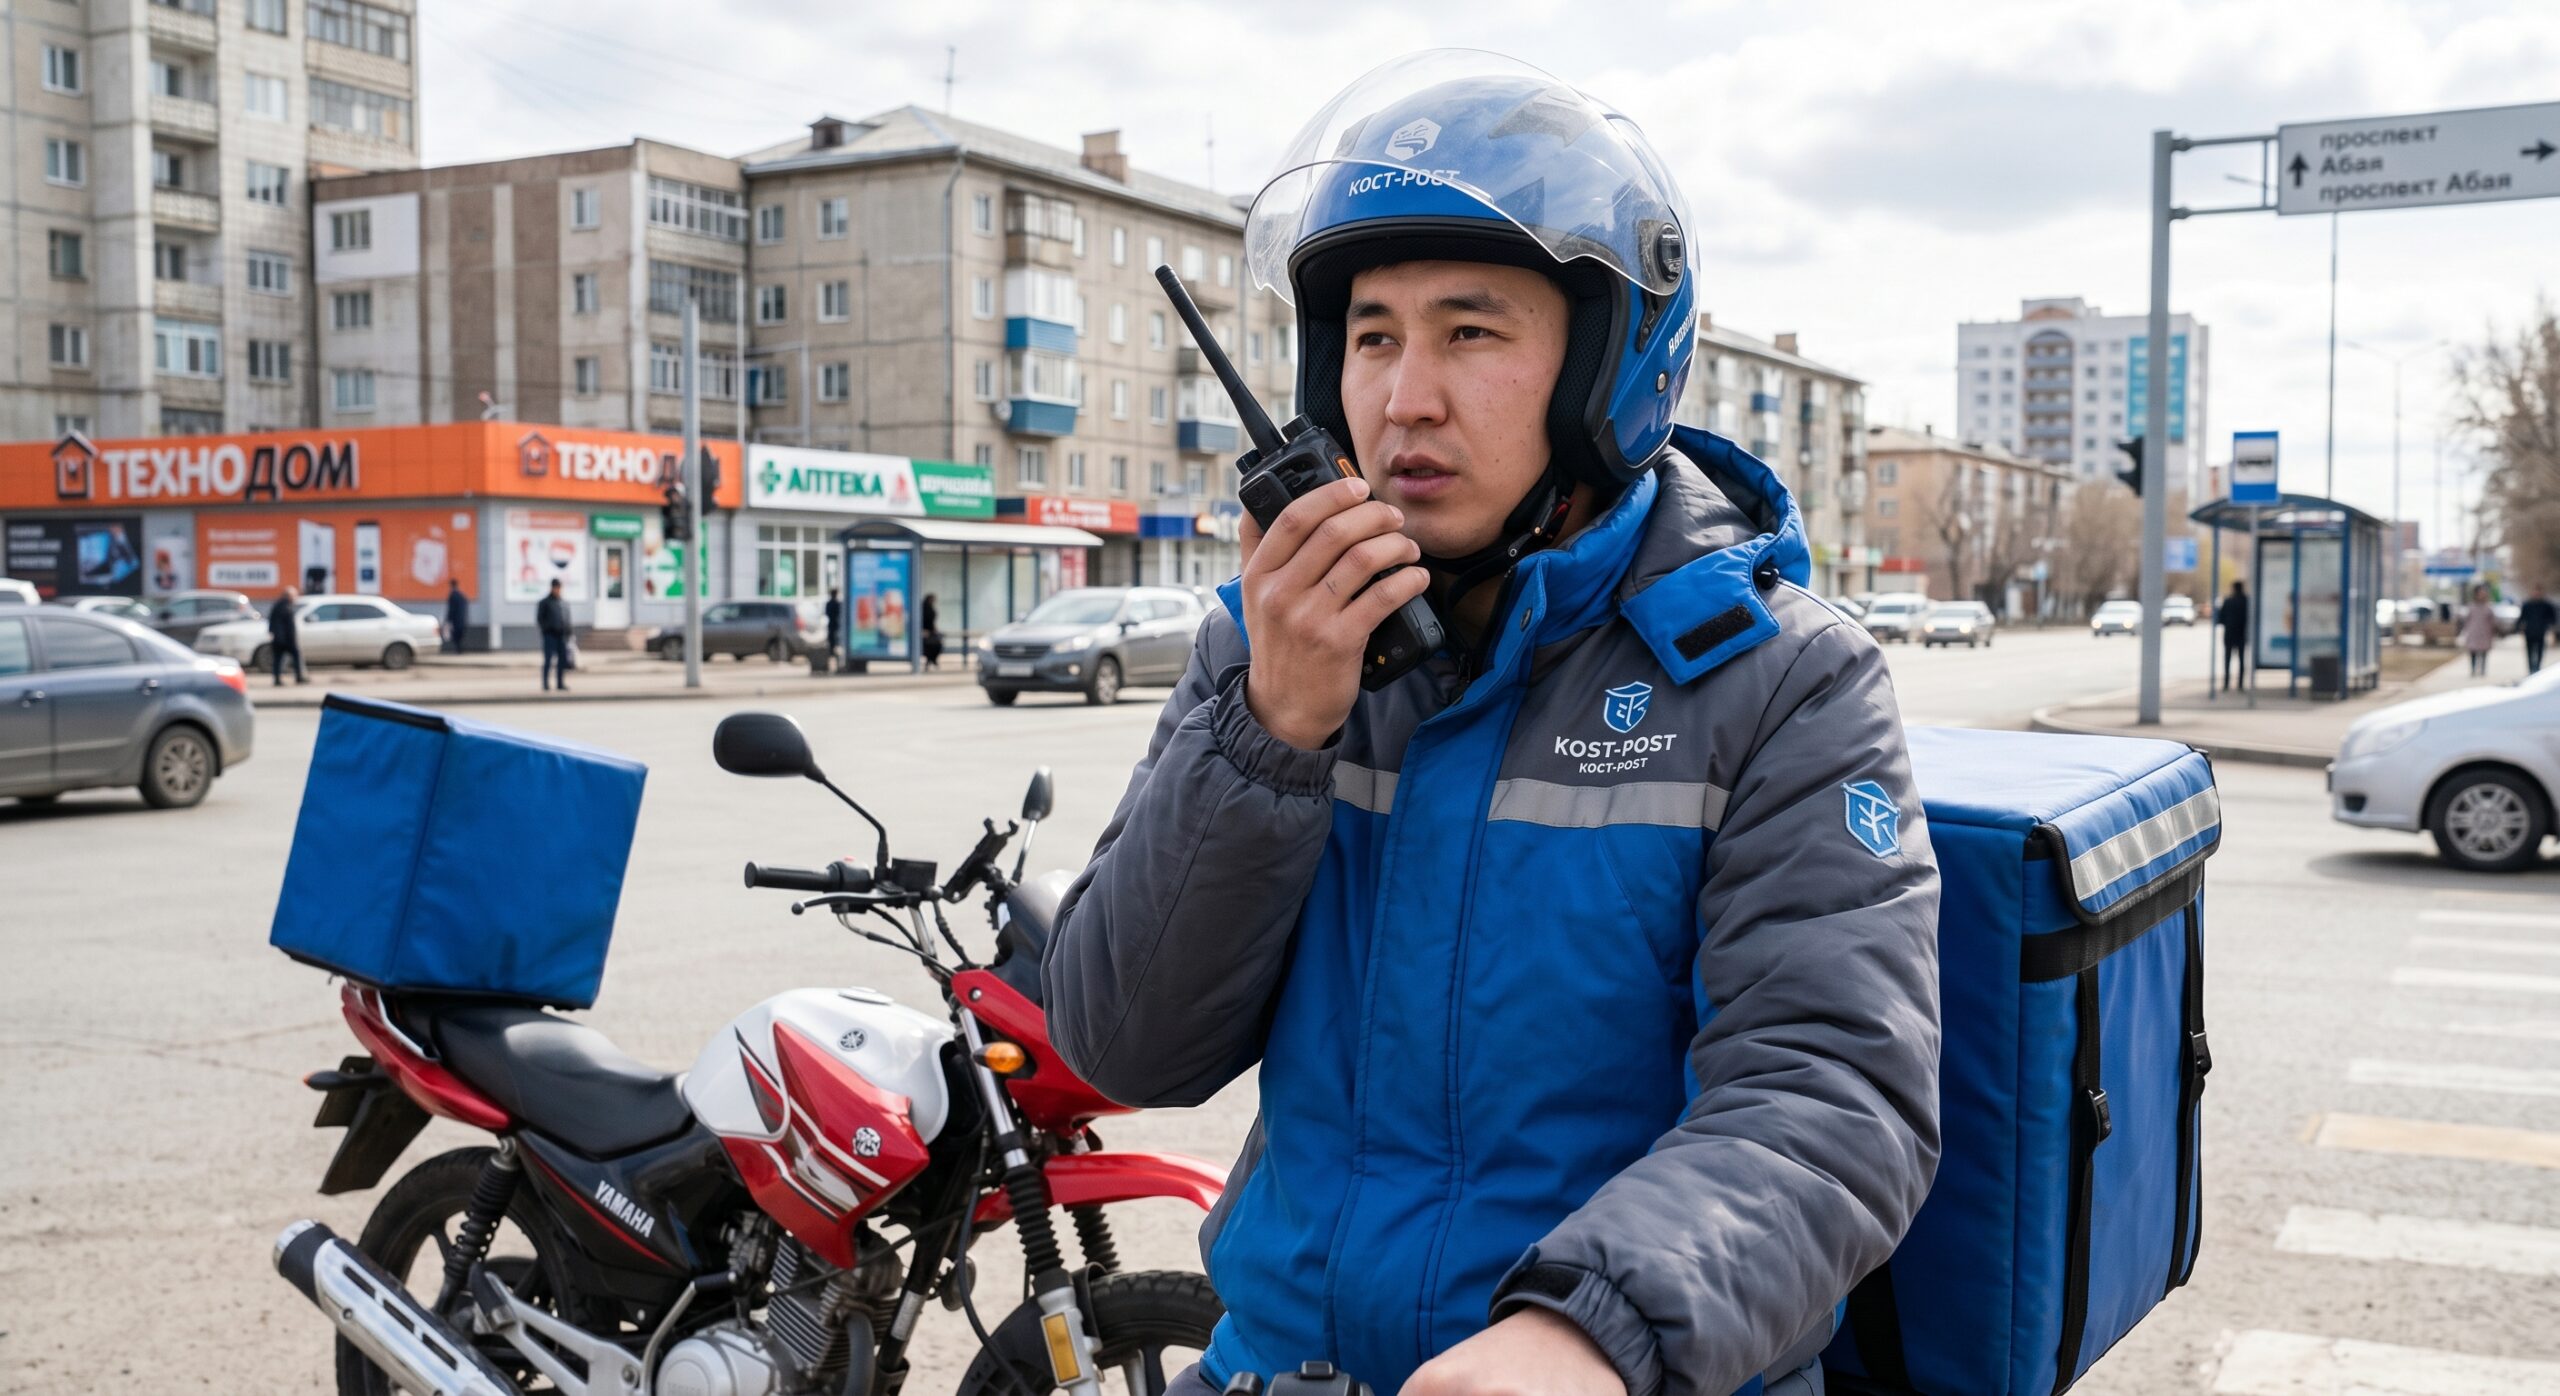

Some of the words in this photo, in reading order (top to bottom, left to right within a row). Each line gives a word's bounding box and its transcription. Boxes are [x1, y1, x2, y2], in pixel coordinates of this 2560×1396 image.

[2320, 125, 2438, 151] проспект
[2319, 154, 2384, 176] Абая
[2319, 178, 2437, 205] проспект
[2446, 170, 2513, 194] Абая
[102, 438, 360, 502] ТЕХНОДОМ
[787, 466, 884, 497] АПТЕКА
[1554, 734, 1677, 758] KOST-POST
[595, 1179, 656, 1238] YAMAHA
